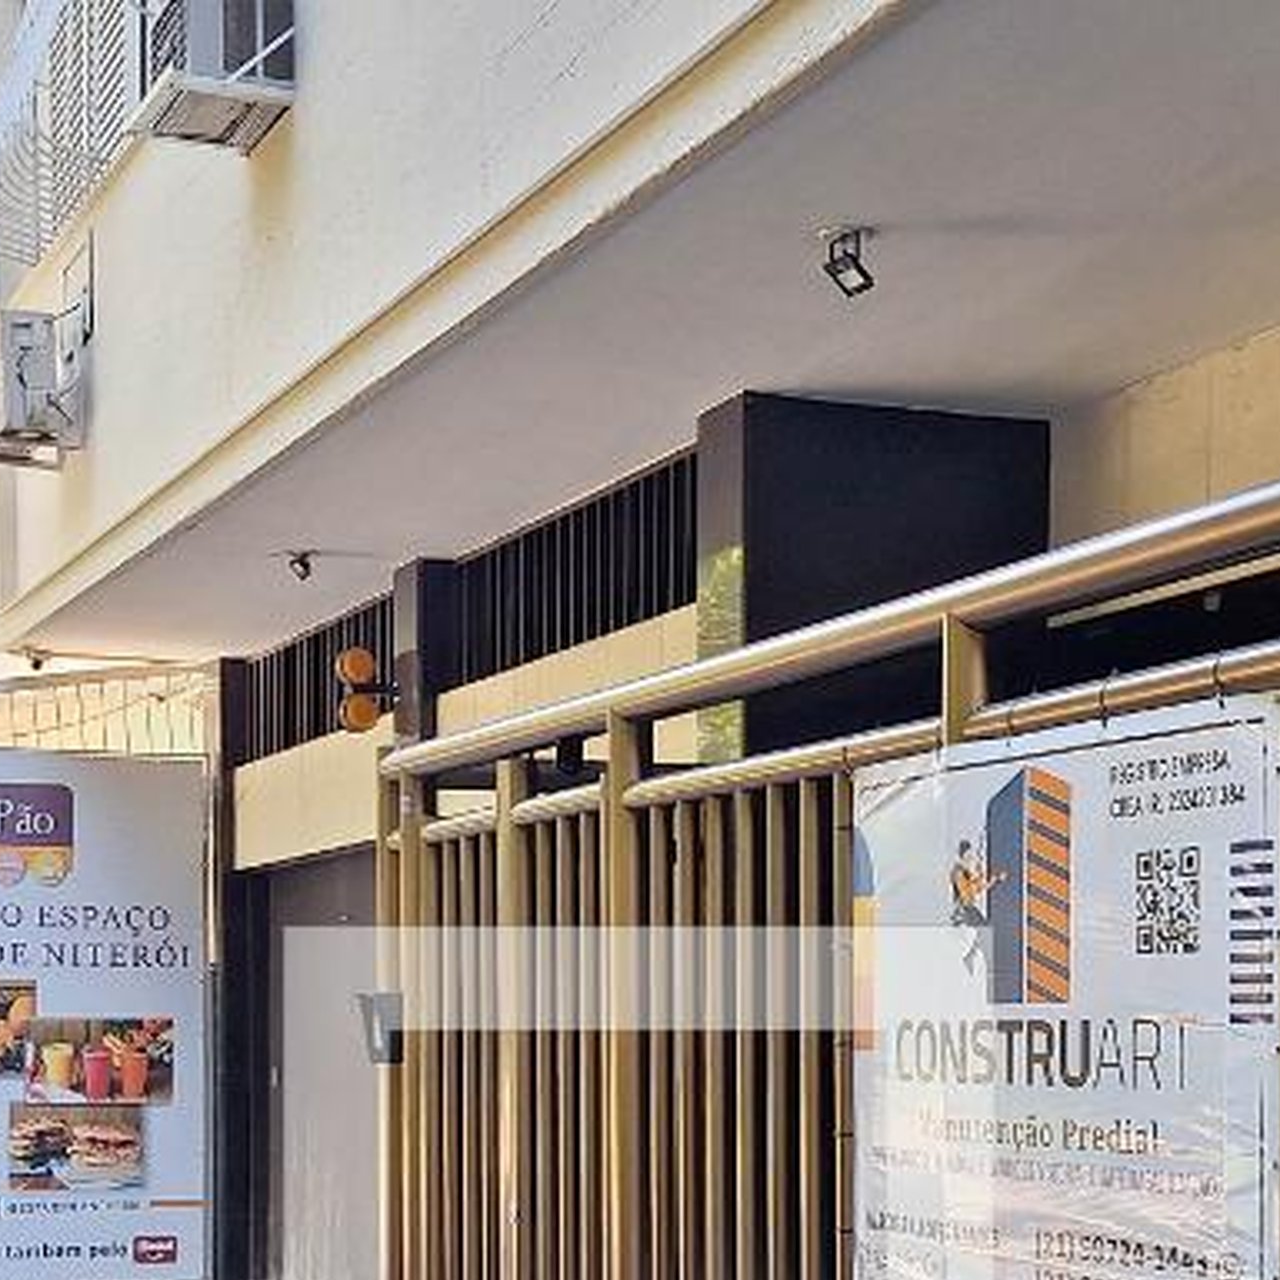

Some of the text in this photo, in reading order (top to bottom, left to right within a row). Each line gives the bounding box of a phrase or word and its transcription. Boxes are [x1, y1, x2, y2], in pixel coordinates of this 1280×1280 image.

[37, 904, 172, 937] ESPAÇO
[42, 936, 189, 968] NITERÓI
[895, 1017, 1196, 1091] CONSTRUART
[1062, 1118, 1160, 1155] Predial
